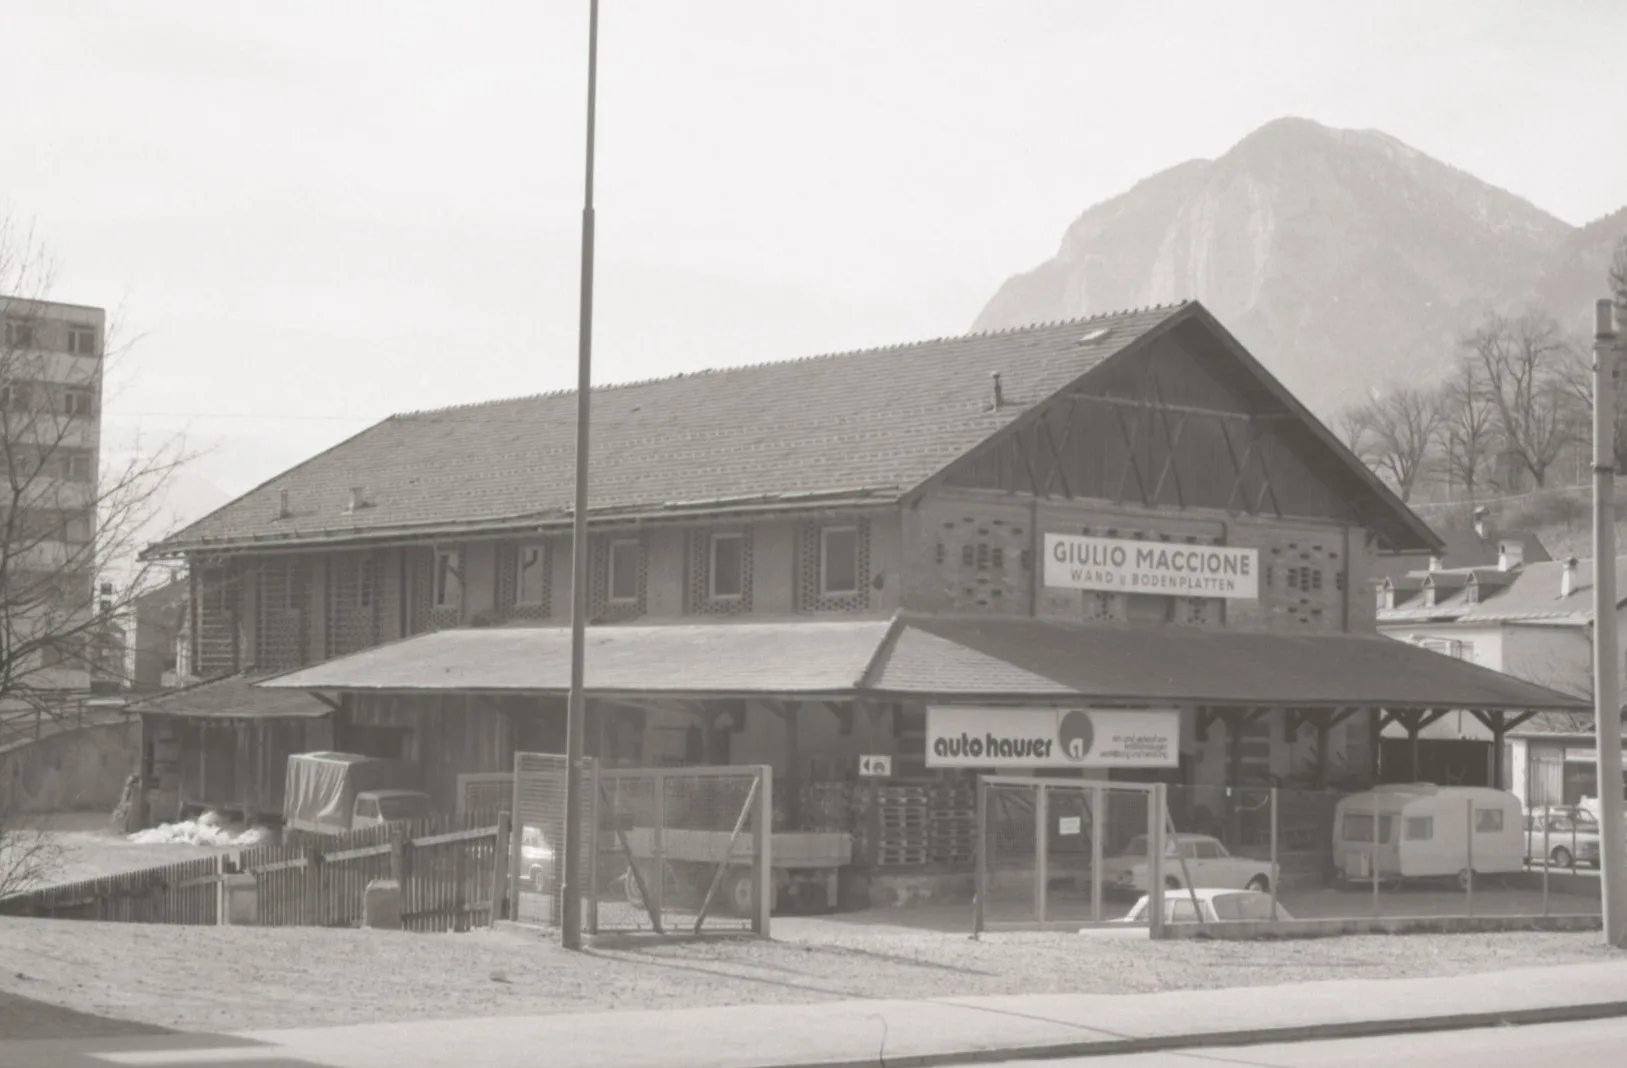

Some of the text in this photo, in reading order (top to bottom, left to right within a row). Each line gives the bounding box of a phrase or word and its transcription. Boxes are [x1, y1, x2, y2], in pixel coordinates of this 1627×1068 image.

[1053, 541, 1250, 575] GIULIO MACCIONE
[1070, 568, 1113, 584] WAND
[1132, 573, 1235, 591] BODENPLATTEN
